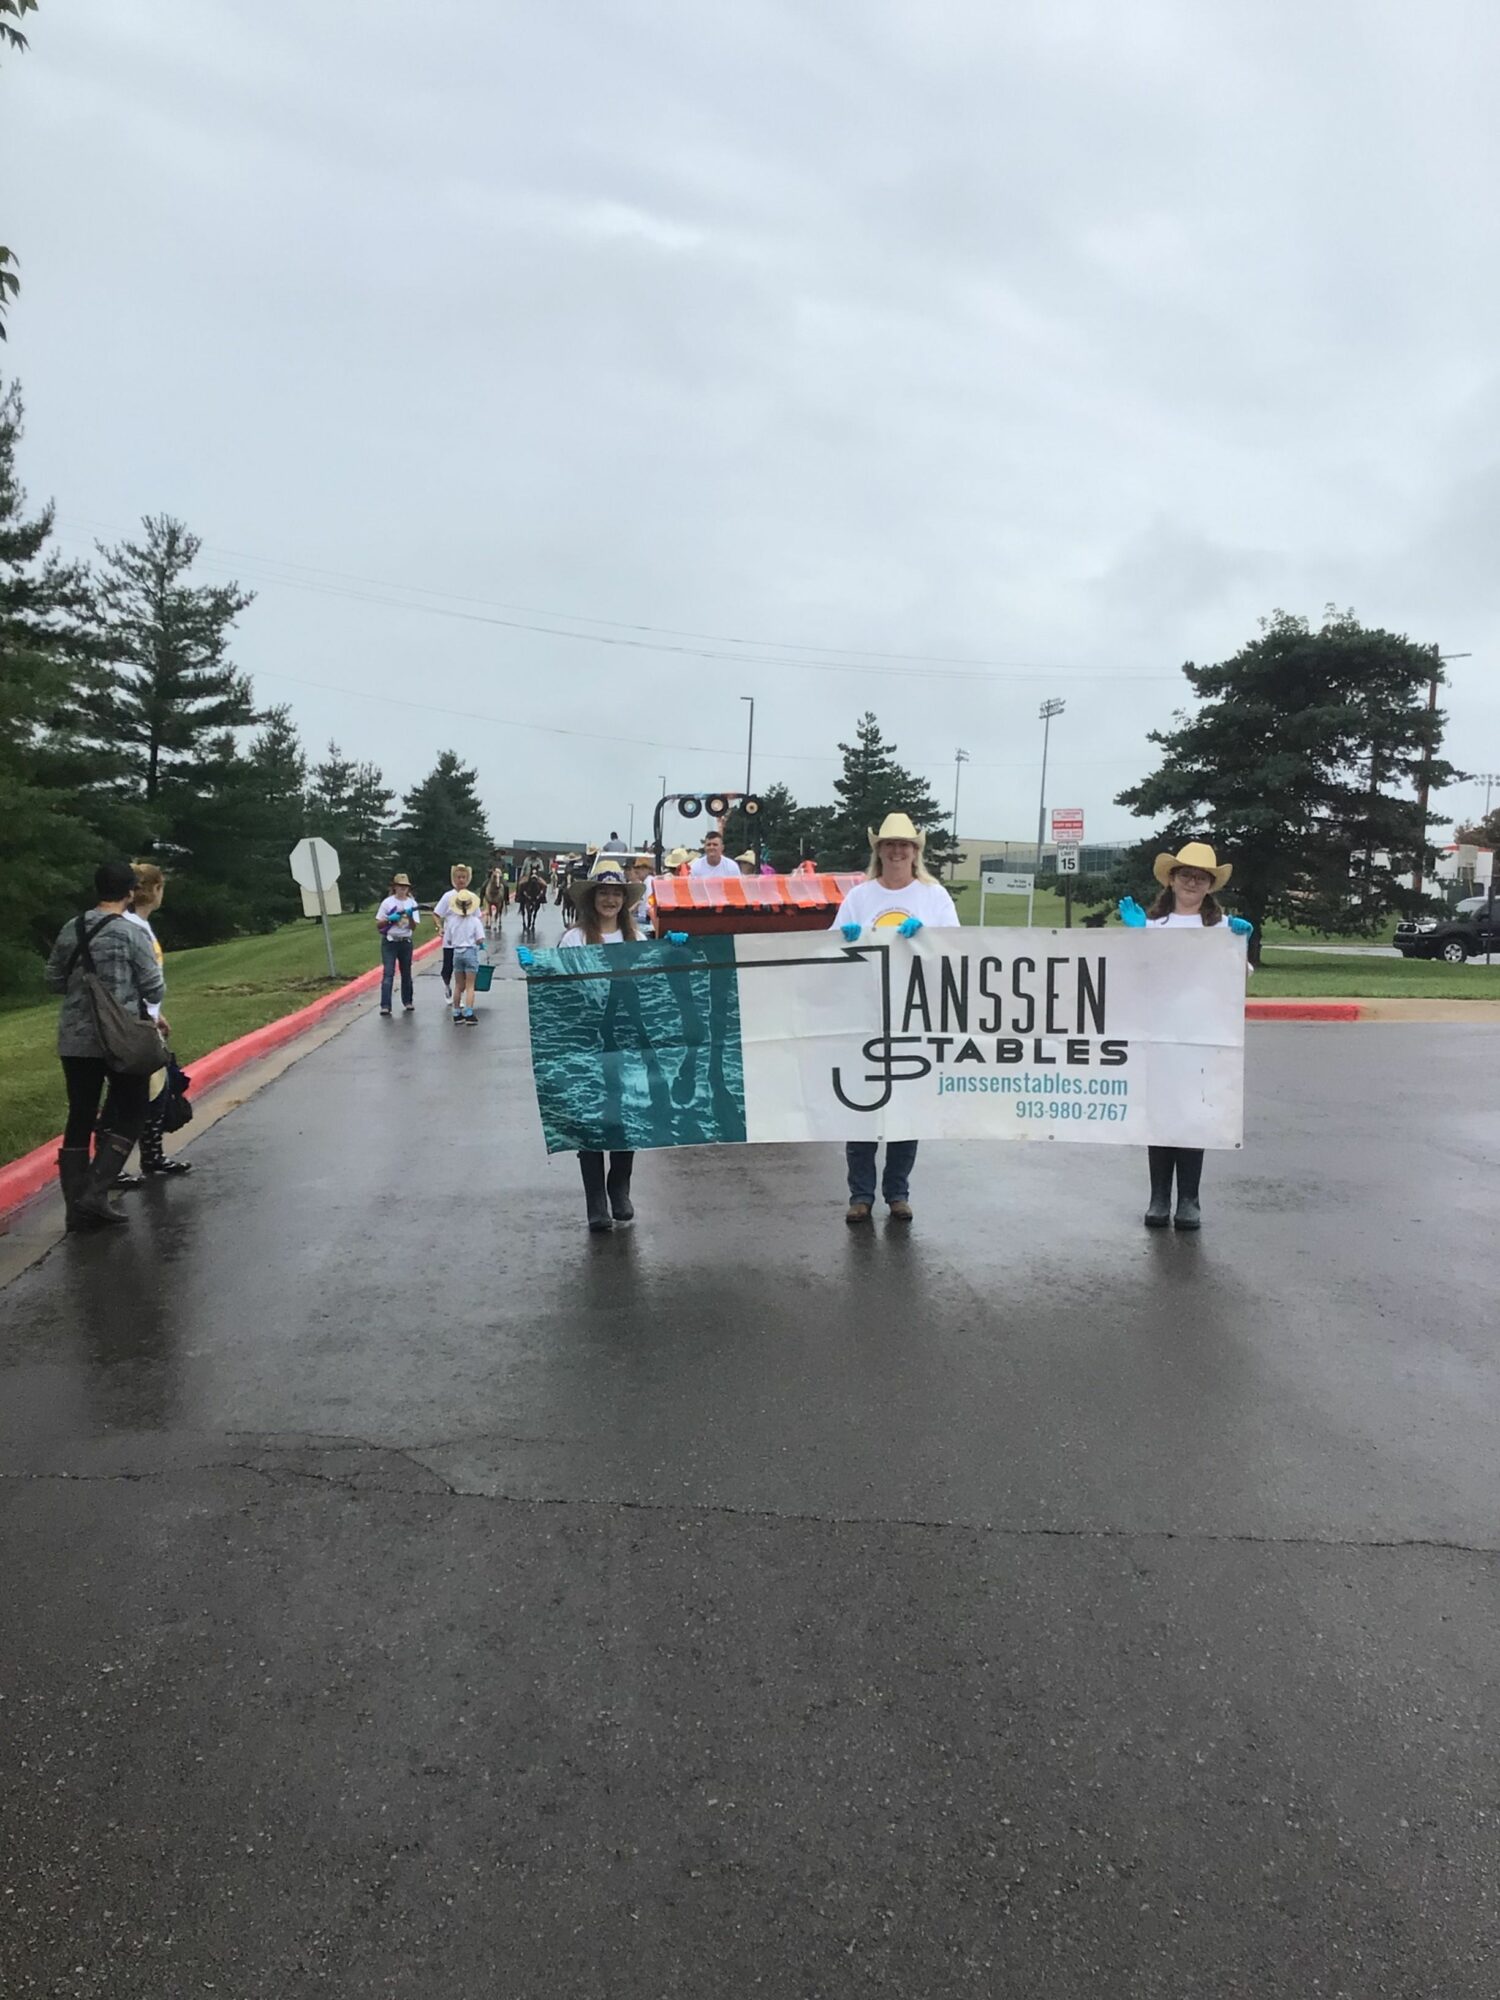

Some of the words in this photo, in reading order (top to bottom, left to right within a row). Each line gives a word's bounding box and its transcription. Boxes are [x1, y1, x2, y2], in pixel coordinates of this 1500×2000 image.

[1061, 858, 1076, 870] 15
[862, 1035, 1128, 1081] STABLES
[937, 1072, 1128, 1096] janssenstables.com
[1015, 1101, 1127, 1121] 913-980-2767
